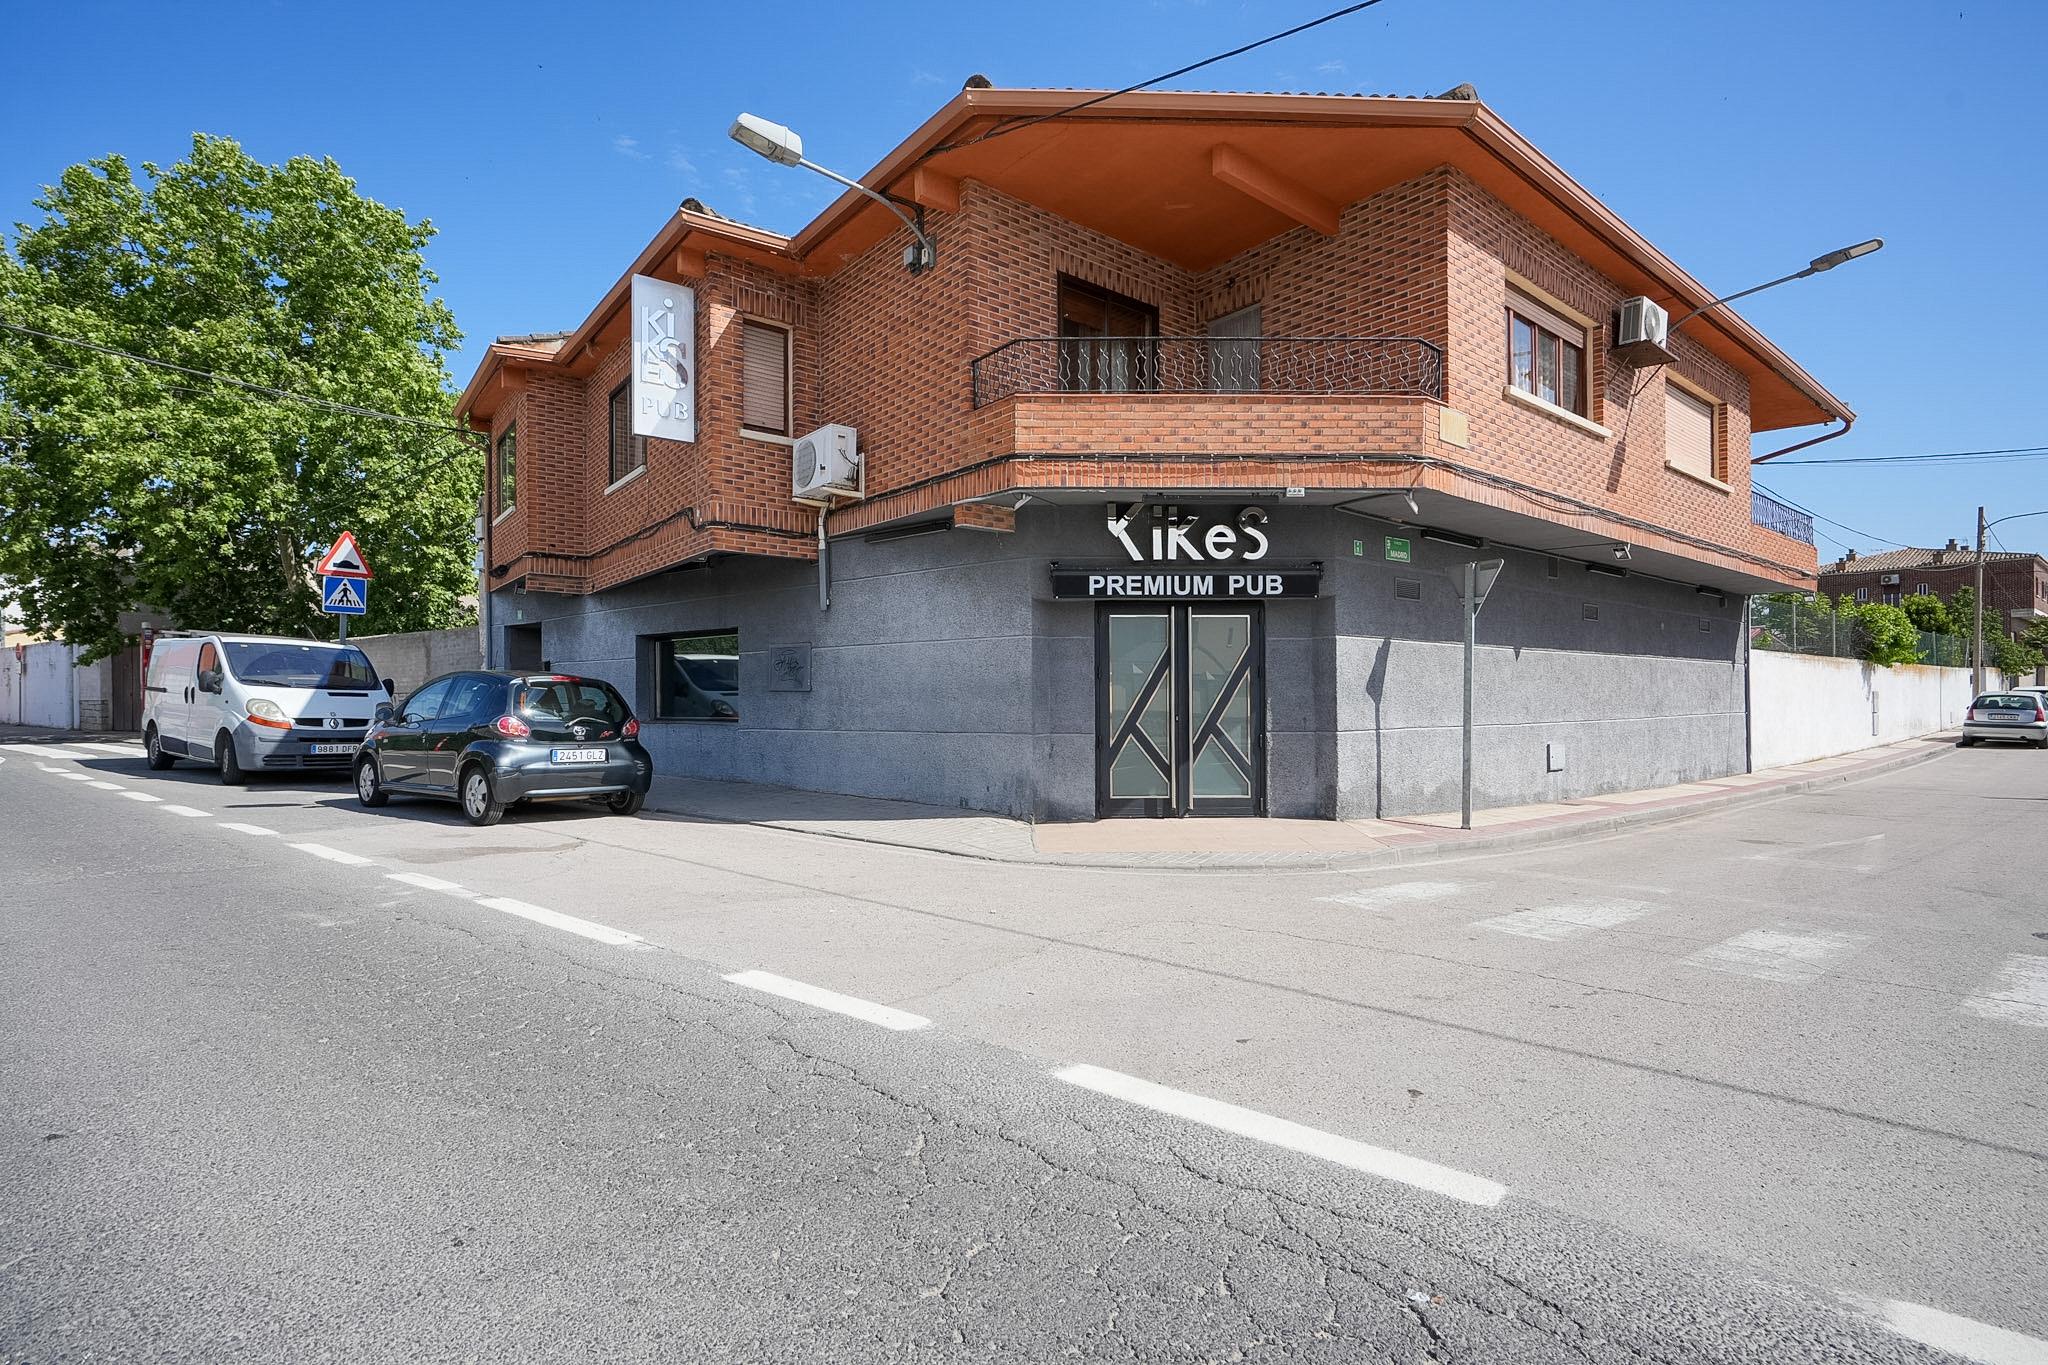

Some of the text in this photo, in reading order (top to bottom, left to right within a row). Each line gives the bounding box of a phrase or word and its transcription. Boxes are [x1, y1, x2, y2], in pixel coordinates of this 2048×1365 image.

[641, 397, 689, 420] PUB
[1088, 575, 1284, 596] PREMIUM PUB
[559, 750, 605, 761] 2451 GLZ
